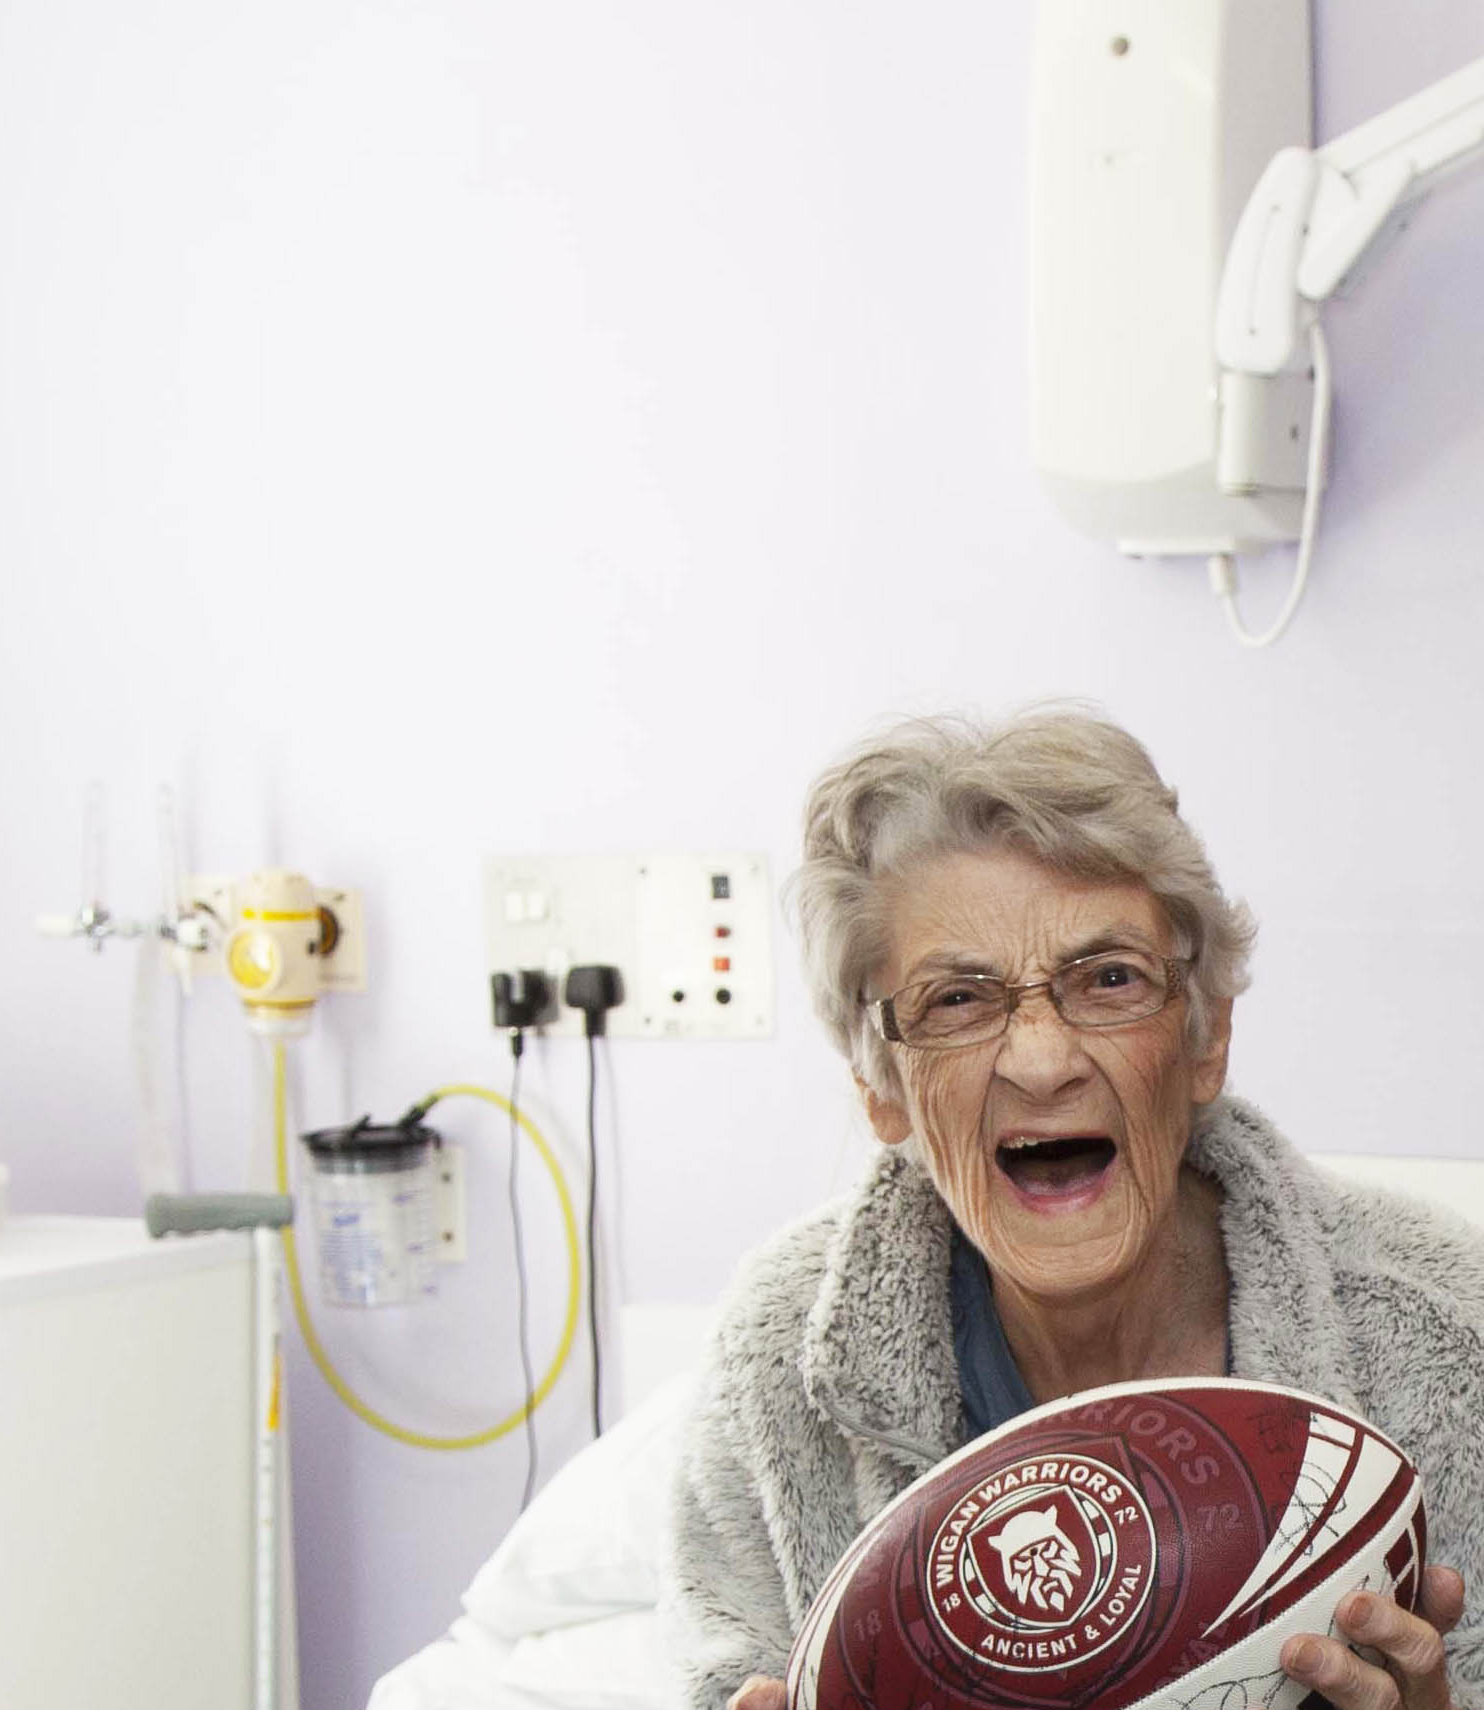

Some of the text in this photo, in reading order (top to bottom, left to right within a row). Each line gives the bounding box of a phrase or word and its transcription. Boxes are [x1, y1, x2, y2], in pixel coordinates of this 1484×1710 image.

[936, 1501, 980, 1588] WIGAN
[978, 1461, 1123, 1503] WARRIORS
[1114, 1506, 1139, 1525] 72
[942, 1593, 962, 1612] 18
[981, 1564, 1142, 1660] ANCIENT & LOYAL
